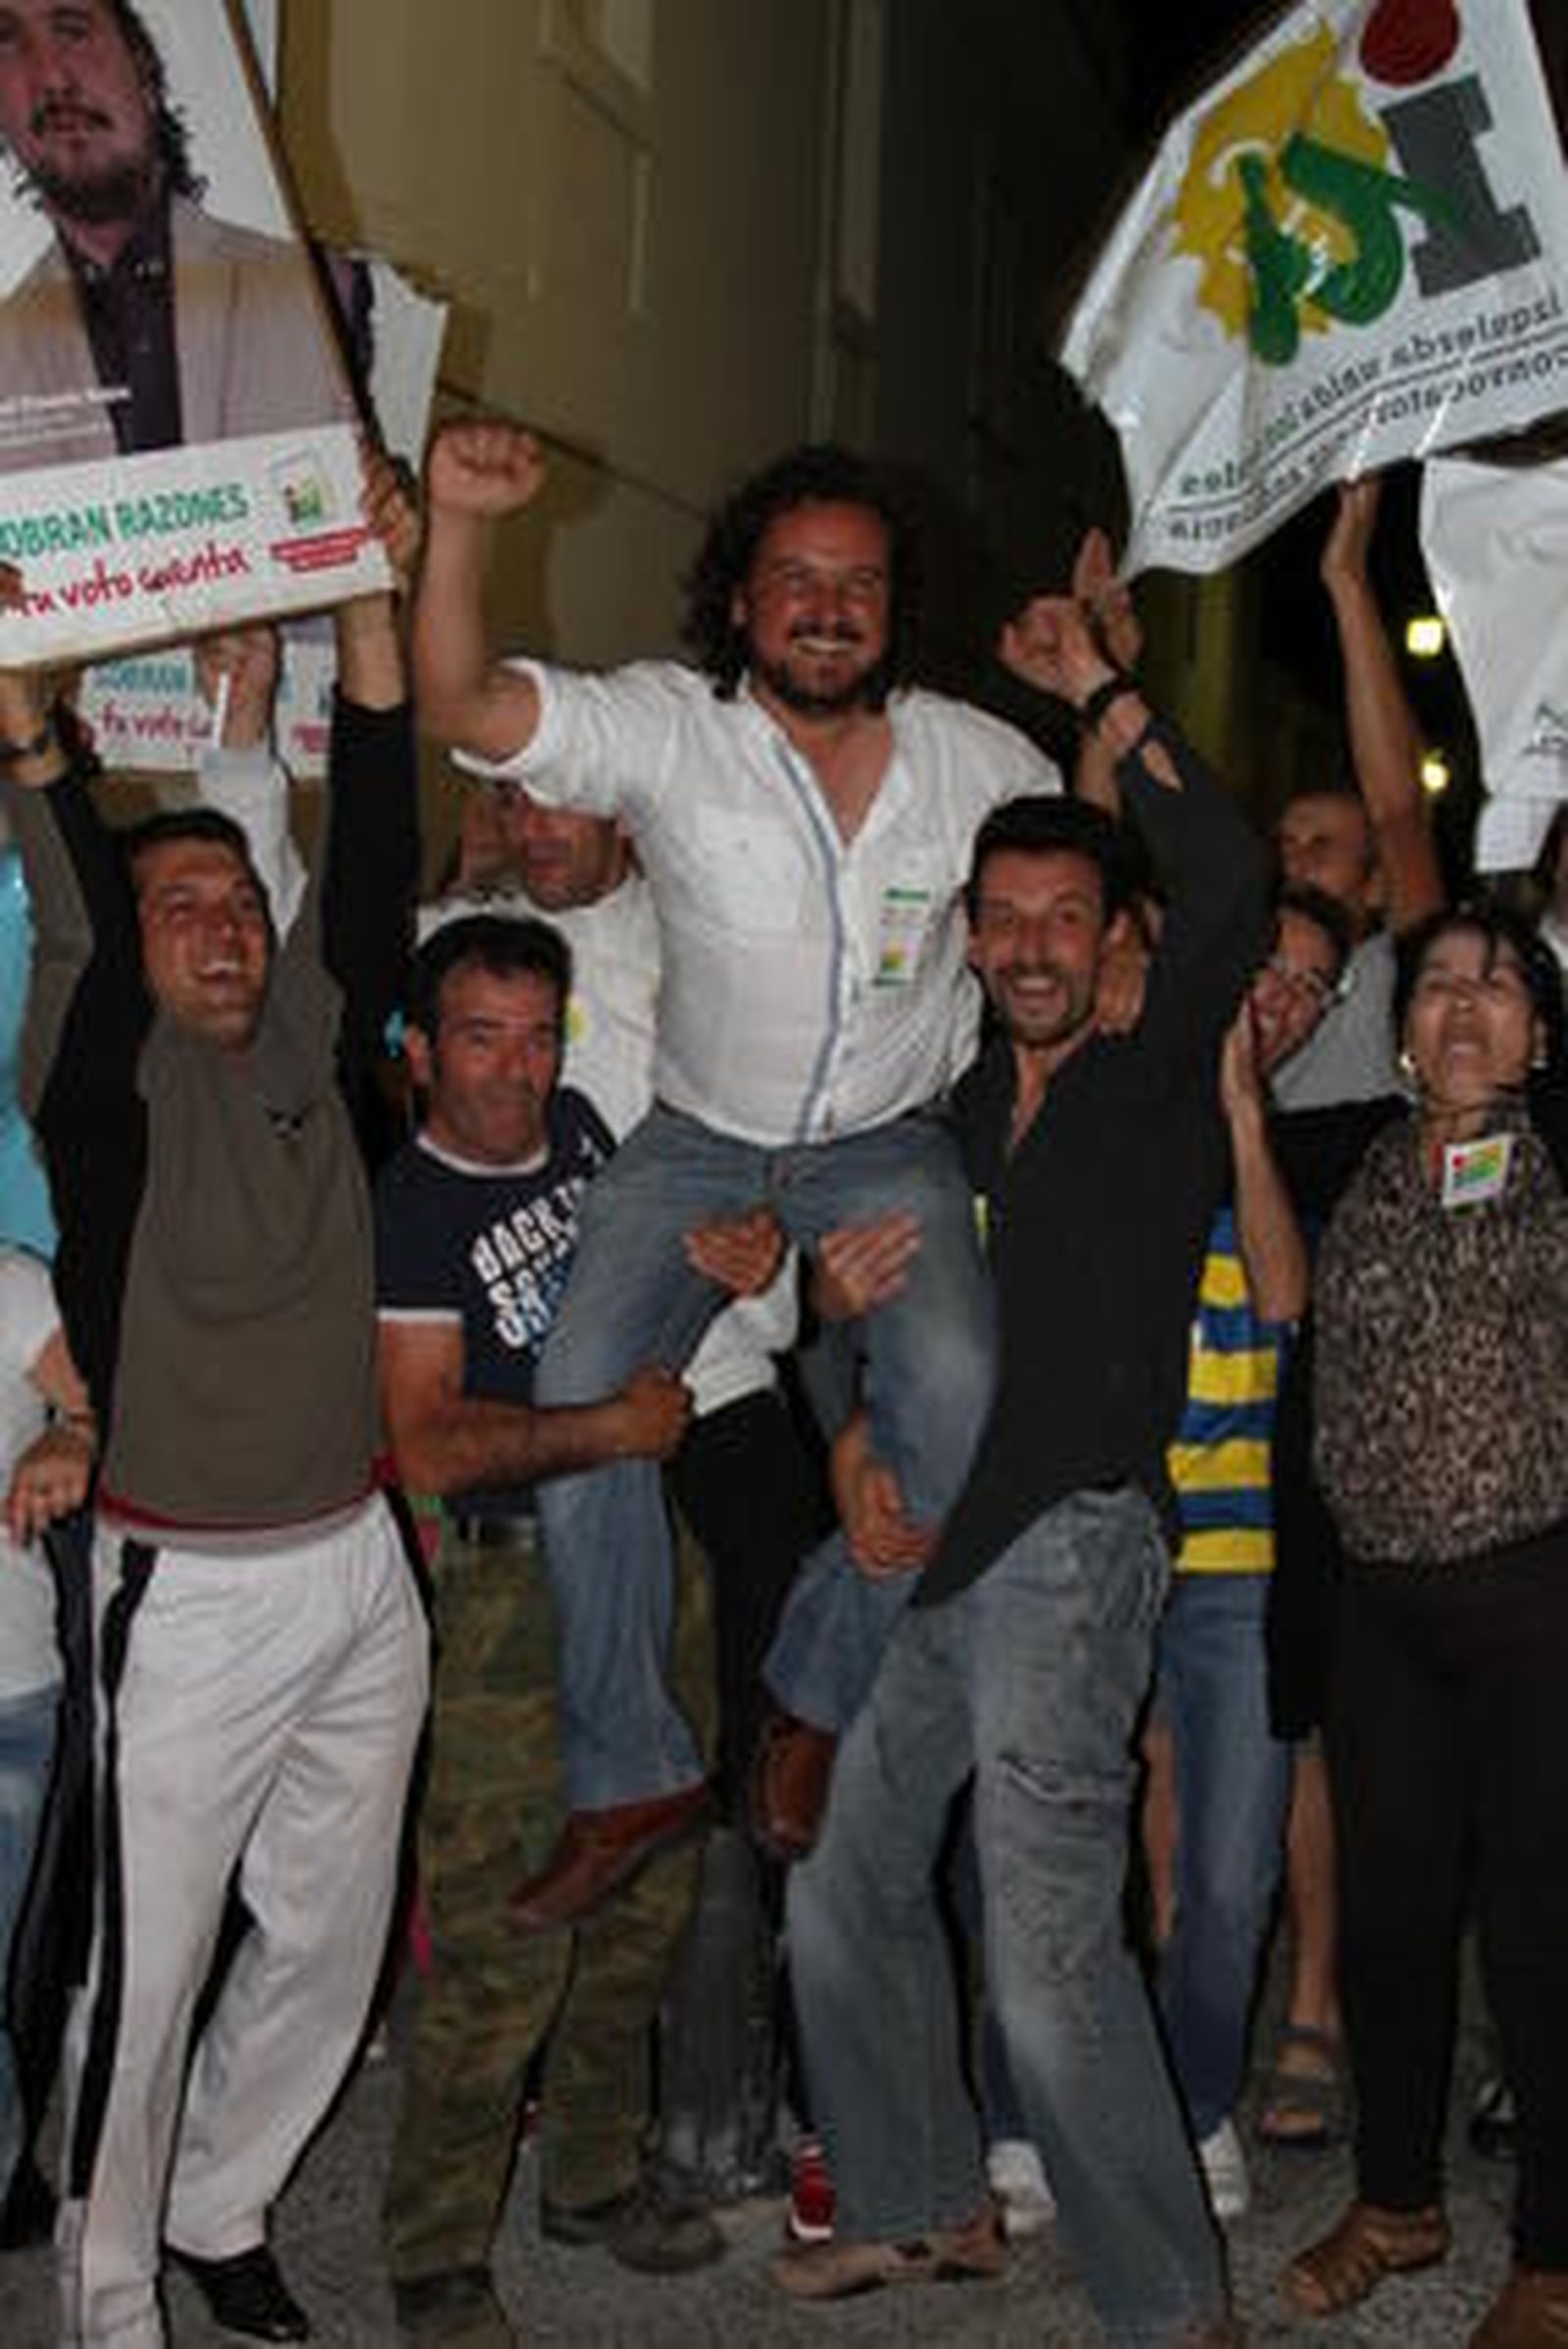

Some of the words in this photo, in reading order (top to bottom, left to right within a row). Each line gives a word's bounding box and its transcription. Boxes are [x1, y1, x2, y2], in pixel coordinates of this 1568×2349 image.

[0, 504, 113, 559] OBRAN
[115, 483, 250, 541] RAZONES
[59, 557, 133, 608] voto
[137, 540, 253, 593] cuenta
